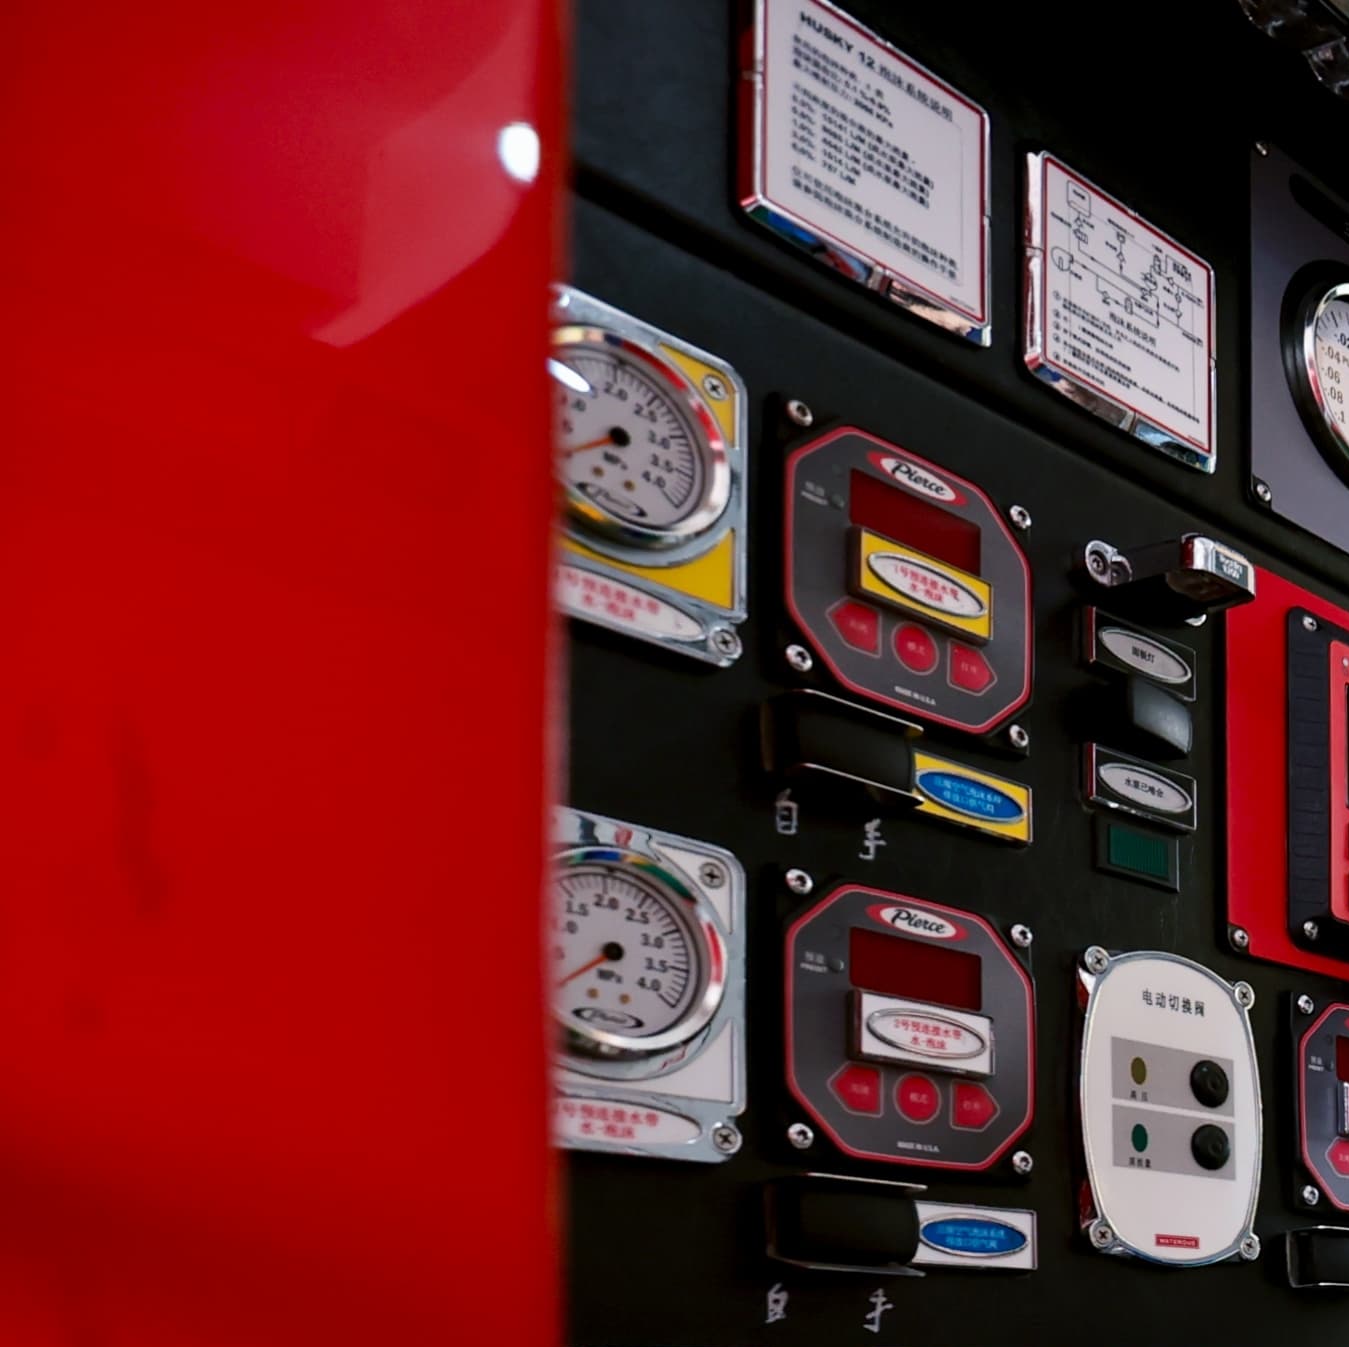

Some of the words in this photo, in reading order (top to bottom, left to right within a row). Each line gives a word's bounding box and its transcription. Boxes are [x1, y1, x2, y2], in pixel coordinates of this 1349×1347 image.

[800, 11, 854, 53] HUSKY
[859, 50, 876, 71] 12
[891, 459, 946, 497] Pierce
[593, 892, 619, 911] 2.0
[891, 907, 946, 934] Pierce
[1142, 987, 1205, 1017] 电动切换阀
